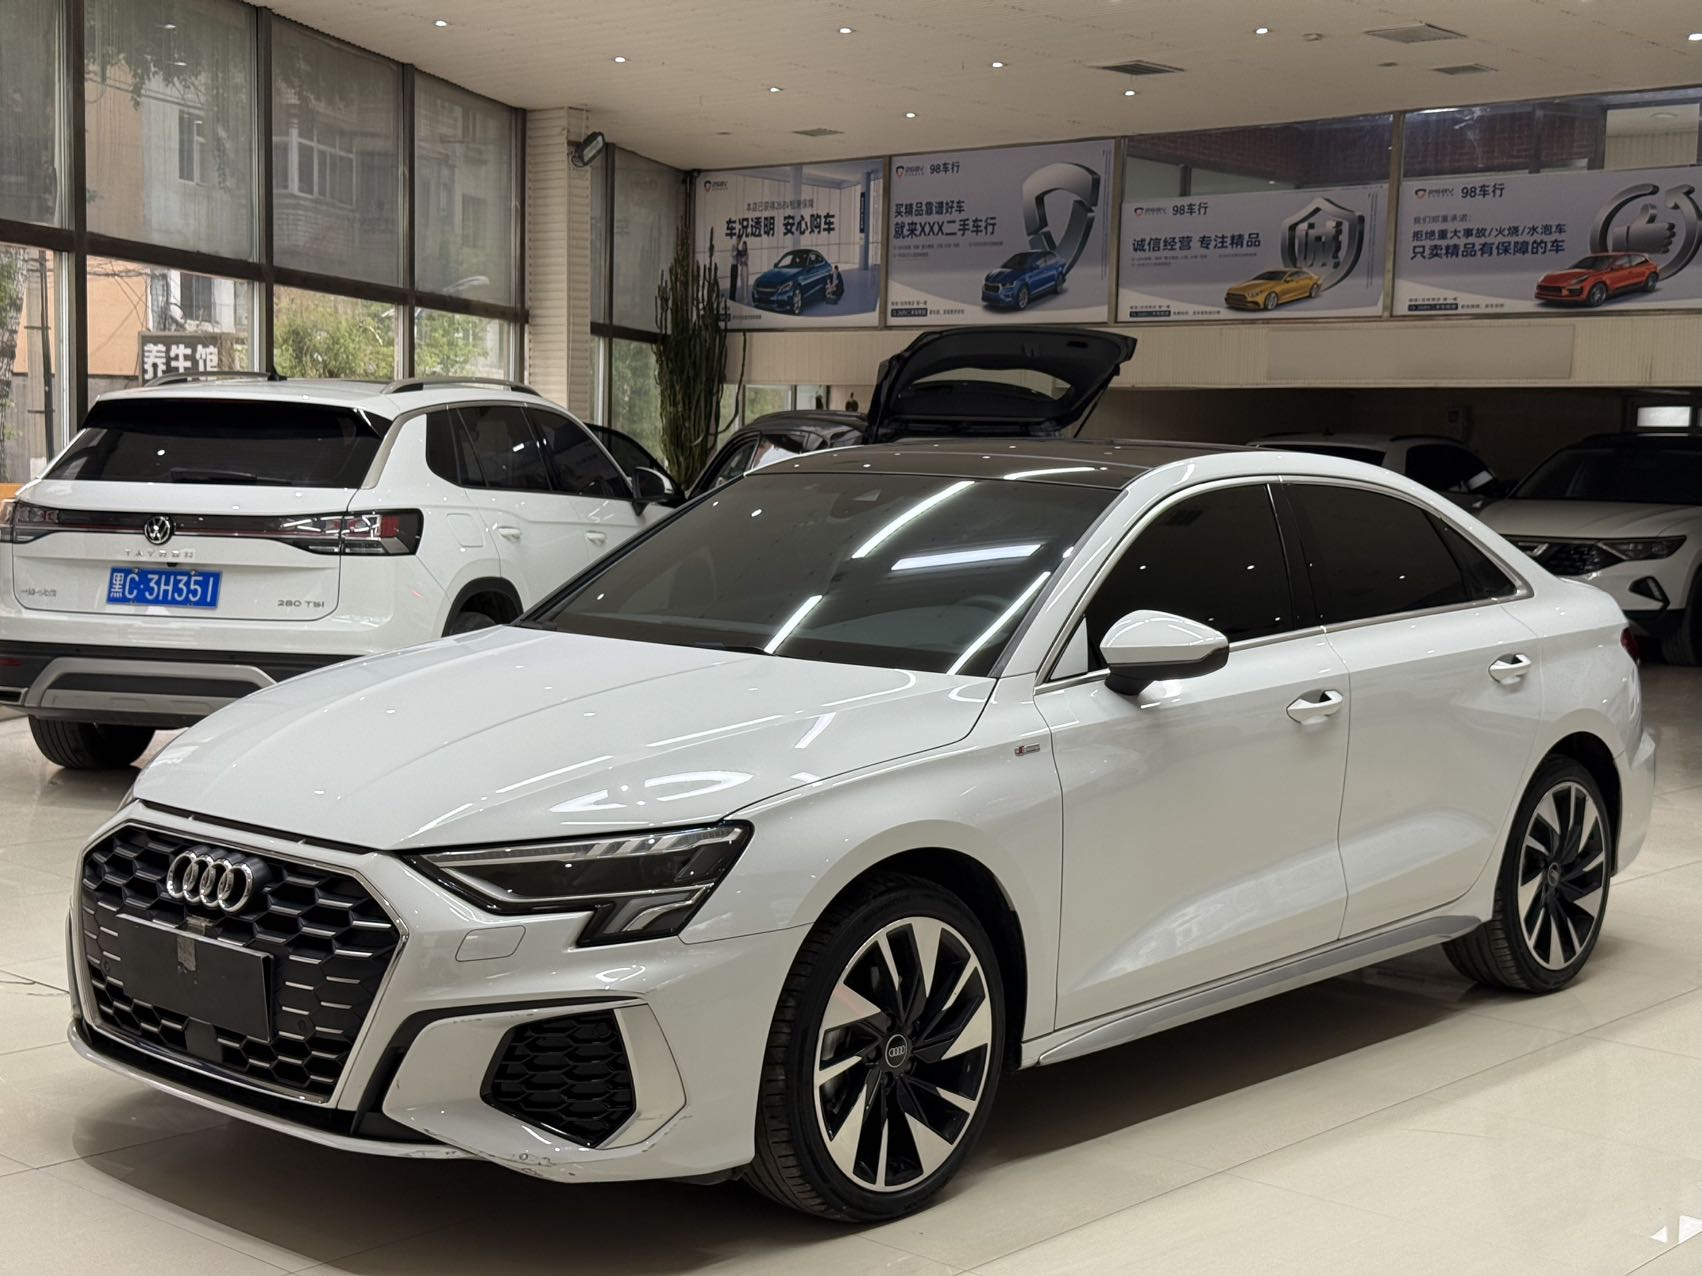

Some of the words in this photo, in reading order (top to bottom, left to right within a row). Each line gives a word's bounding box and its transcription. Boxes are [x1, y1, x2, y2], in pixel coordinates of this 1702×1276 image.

[929, 162, 961, 175] 98车行
[1461, 183, 1505, 199] 98车行
[894, 200, 966, 219] 买精品靠谱好车
[1172, 202, 1209, 216] 98车行
[725, 215, 776, 239] 车况透明
[782, 212, 836, 236] 安心购车
[893, 216, 998, 240] 就来XXX二手车行
[1412, 223, 1567, 242] 拒绝重大事故/火烧/水泡车
[1132, 236, 1193, 253] 诚信经营
[1198, 232, 1262, 251] 专注精品
[1410, 238, 1566, 261] 只卖精品有保障的车
